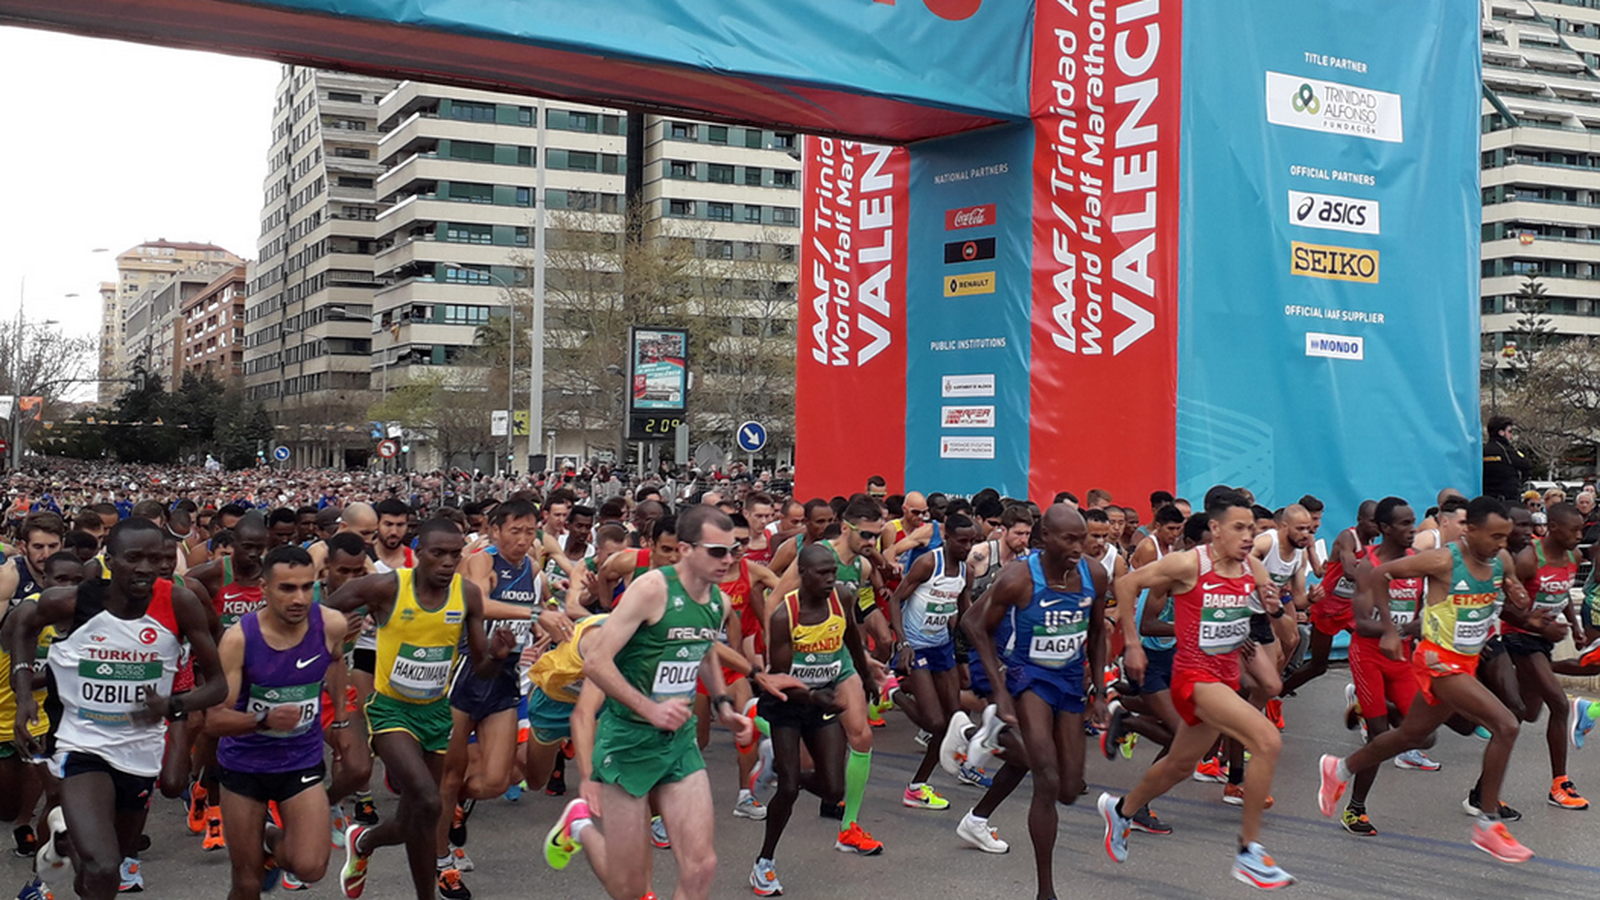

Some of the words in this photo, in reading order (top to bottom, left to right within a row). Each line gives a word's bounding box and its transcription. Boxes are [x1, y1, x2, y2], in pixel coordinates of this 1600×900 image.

[1304, 52, 1328, 66] TITLE
[1330, 57, 1367, 73] PARTNER
[1081, 0, 1106, 166] Marathon
[1324, 86, 1376, 109] TRINIDAD
[1049, 28, 1078, 196] Trinidad
[1323, 103, 1377, 124] ALFONSO
[934, 172, 969, 184] NATIONAL
[970, 163, 1009, 179] PARTNERS
[1112, 0, 1160, 356] VALENCI
[1290, 165, 1330, 180] OFFICIAL
[1332, 170, 1375, 186] PARTNERS
[814, 137, 834, 232] Trinid
[1080, 171, 1104, 244] Half
[1318, 201, 1367, 226] asics
[834, 212, 852, 273] Half
[857, 143, 894, 366] VALEN
[1294, 246, 1375, 278] SEIKO
[959, 279, 989, 289] RENAULT
[1081, 252, 1103, 356] World
[1285, 305, 1323, 318] OFFICIAL
[1324, 308, 1340, 320] IAAF
[1341, 310, 1385, 324] SUPPLIER
[832, 279, 851, 366] World
[930, 340, 956, 351] PUBLIC
[957, 337, 1006, 350] INSTITUTIONS
[1320, 339, 1359, 354] MONDO
[1045, 610, 1083, 626] USA
[1035, 634, 1084, 653] LAGAT
[88, 648, 159, 662] TÜRKİYE
[659, 665, 700, 685] POLLO
[792, 665, 839, 679] KURONG
